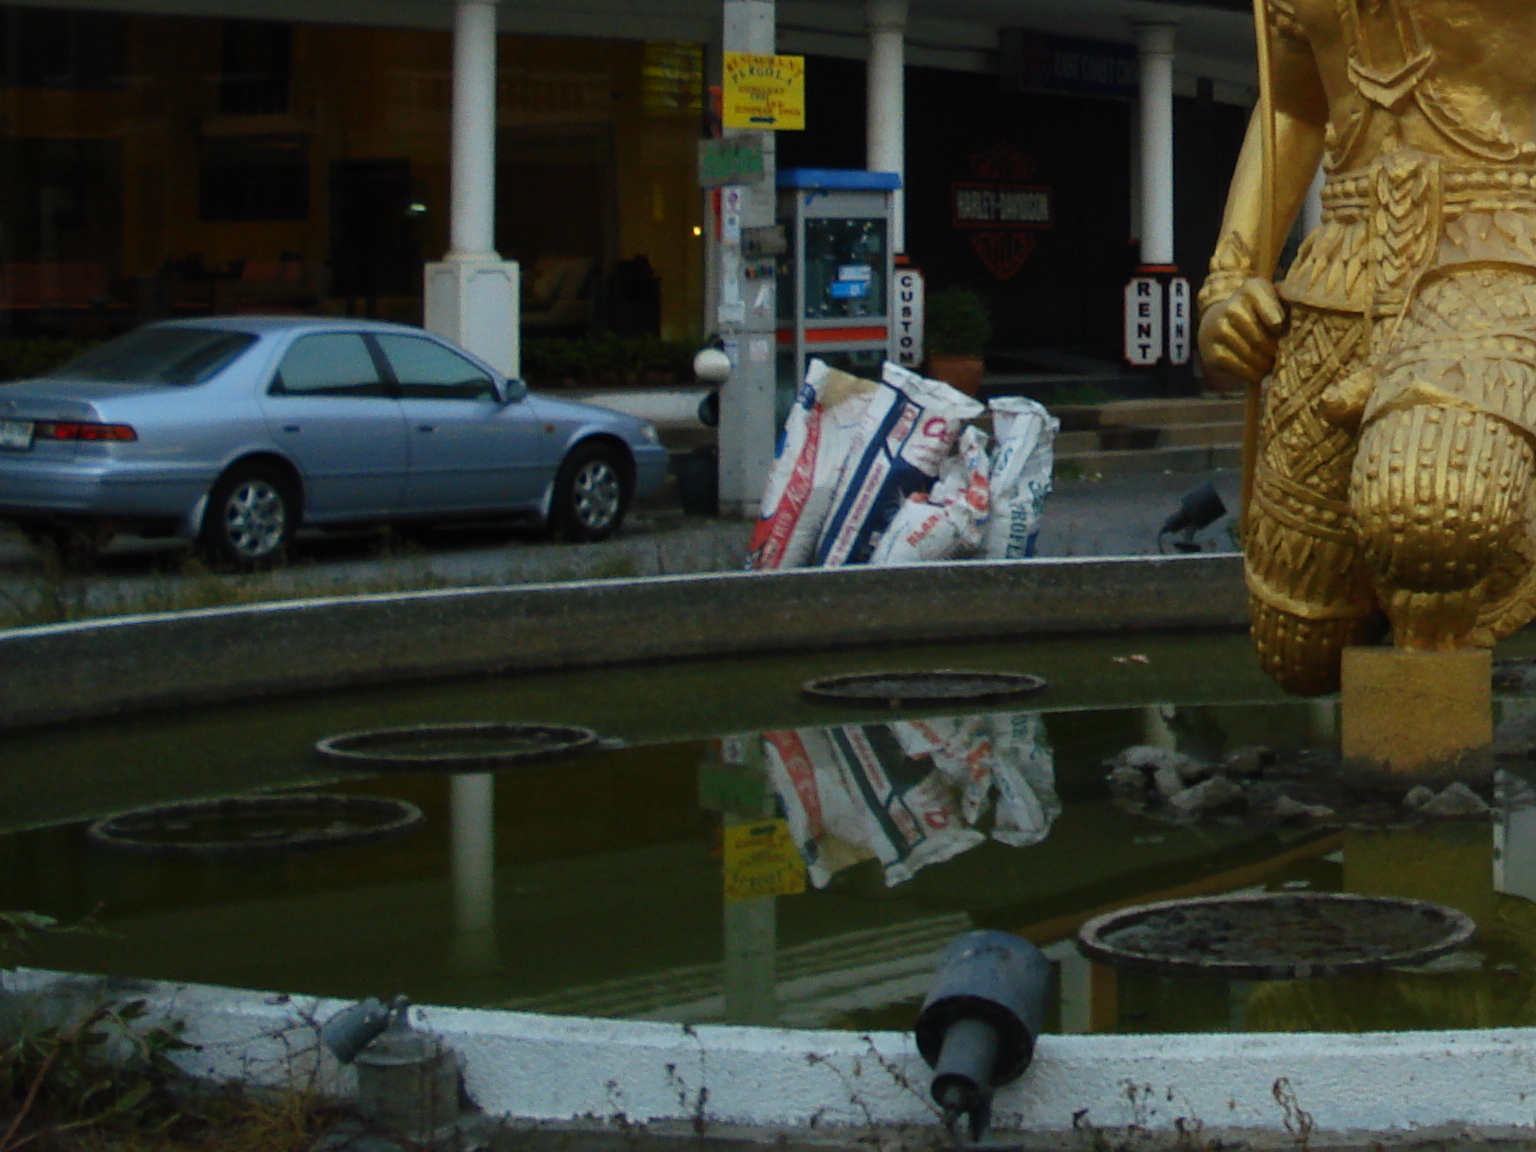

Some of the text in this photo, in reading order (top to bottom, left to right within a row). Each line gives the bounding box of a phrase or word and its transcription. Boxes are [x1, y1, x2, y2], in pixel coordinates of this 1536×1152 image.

[900, 275, 914, 365] CUSTOM
[1136, 282, 1152, 361] RENT
[1174, 282, 1185, 360] RENT
